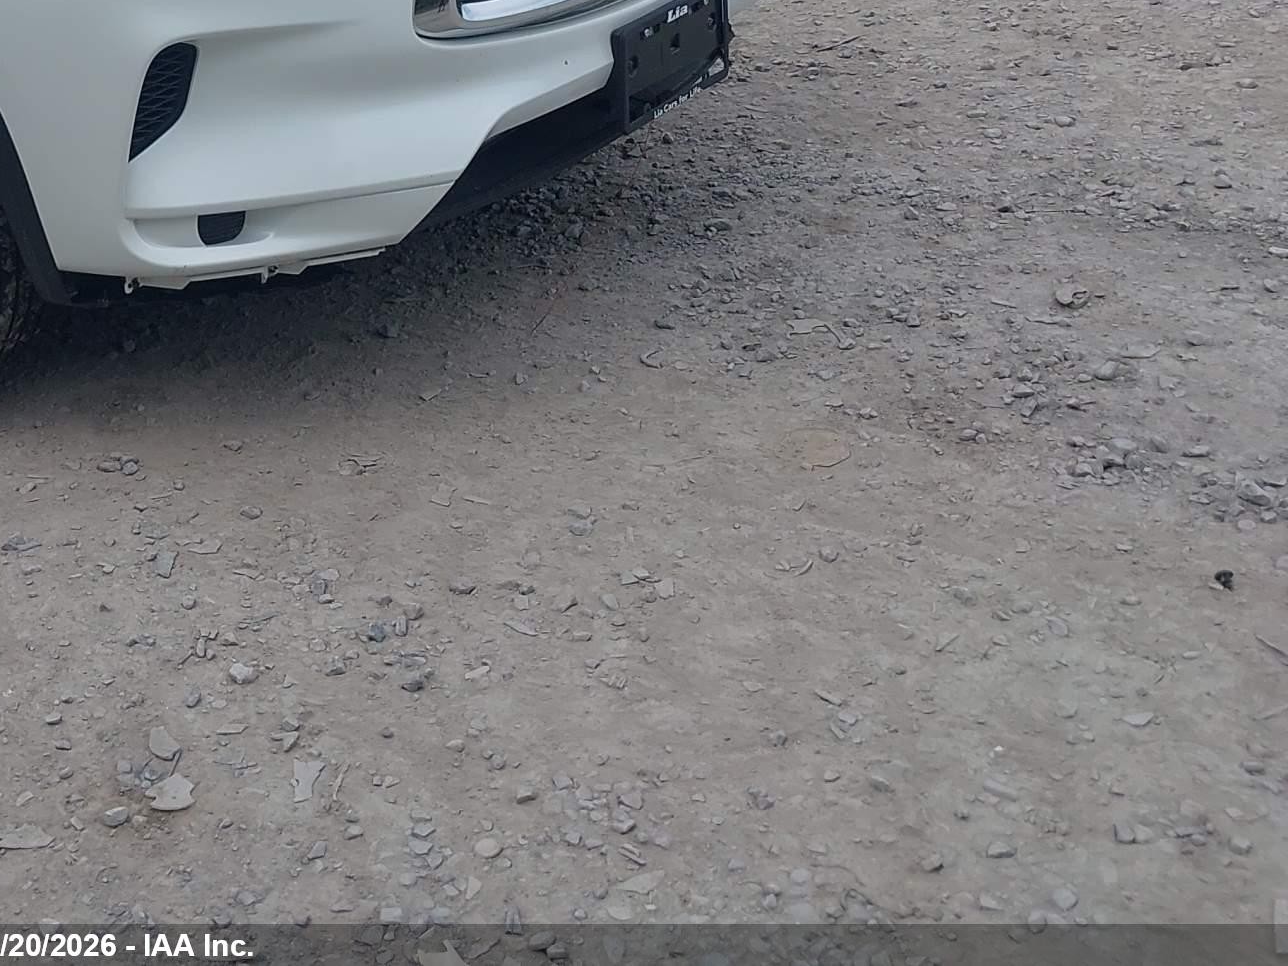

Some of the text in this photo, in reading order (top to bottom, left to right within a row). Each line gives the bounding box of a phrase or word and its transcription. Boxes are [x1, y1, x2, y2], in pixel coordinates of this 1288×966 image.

[667, 4, 688, 23] Lia
[654, 86, 702, 119] Lia Cars for Life
